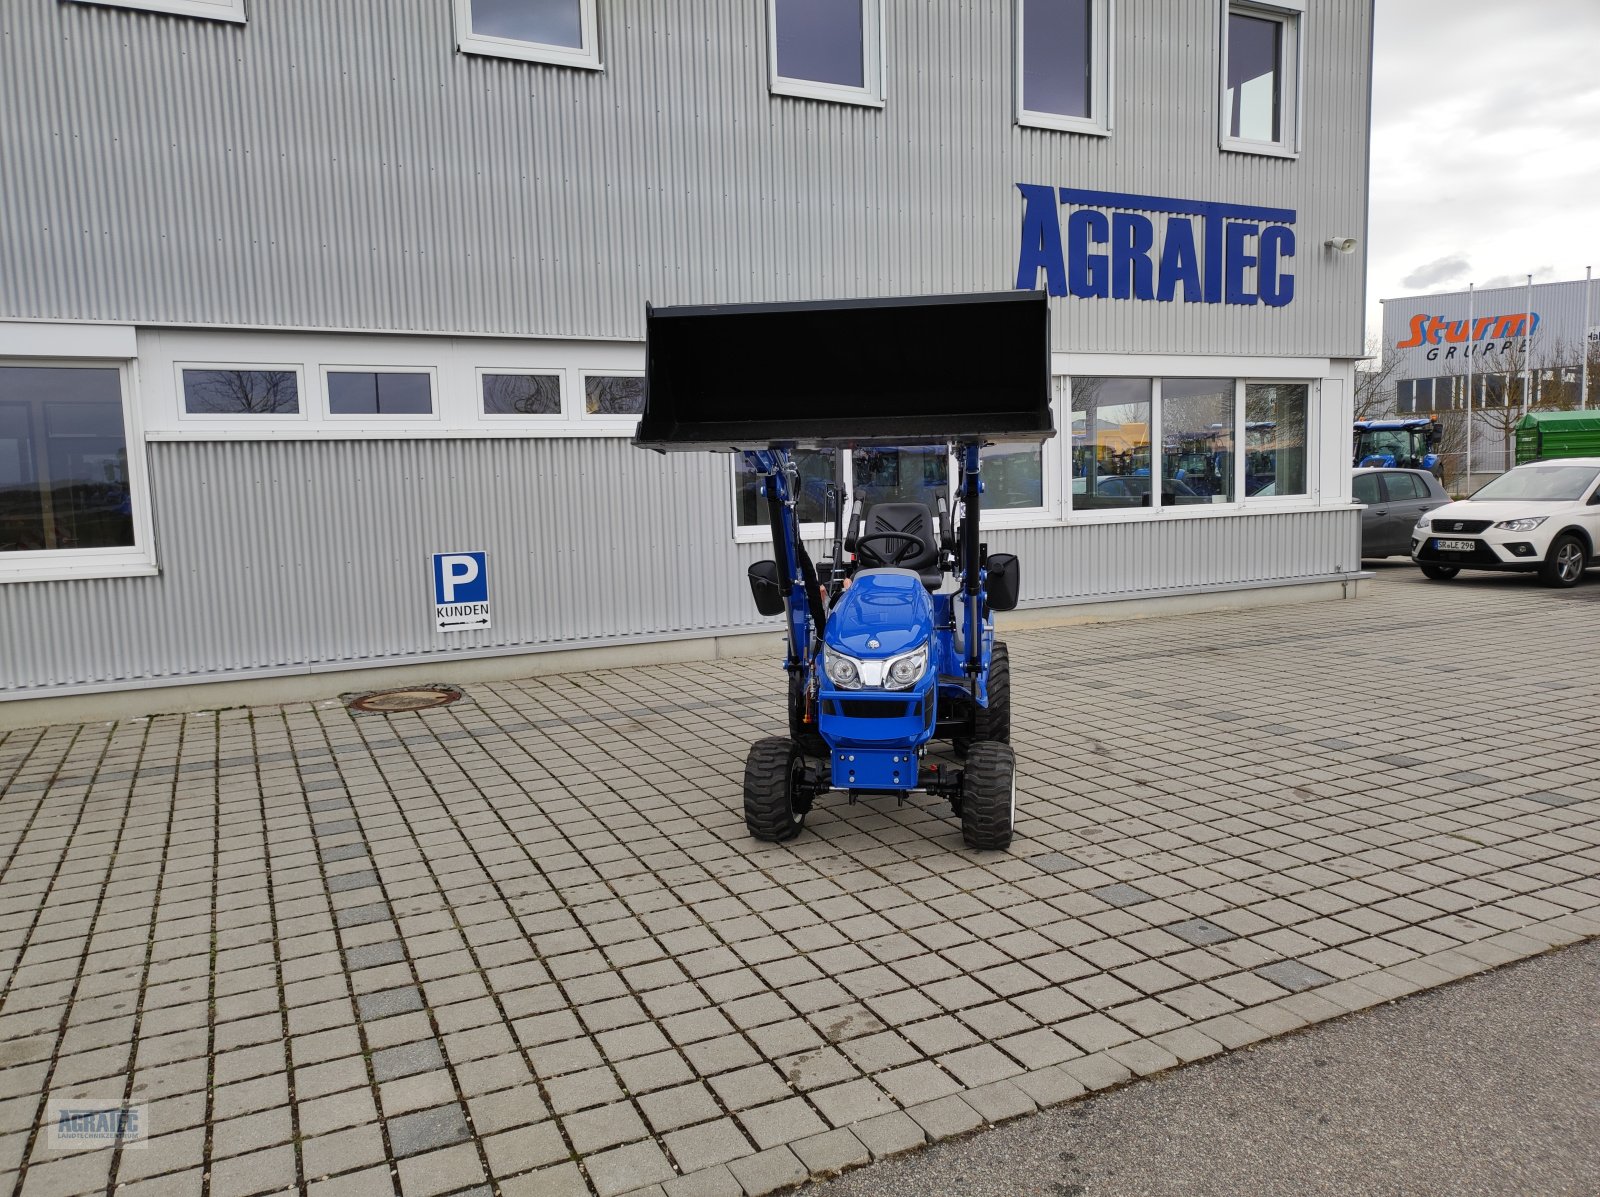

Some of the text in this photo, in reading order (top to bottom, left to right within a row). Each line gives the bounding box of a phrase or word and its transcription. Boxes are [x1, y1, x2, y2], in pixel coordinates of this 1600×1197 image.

[1015, 182, 1297, 308] AGRATEC
[1396, 311, 1541, 349] Sturm
[1426, 337, 1533, 361] GRUPPE
[1460, 541, 1474, 550] 296
[441, 555, 479, 602] P
[436, 603, 489, 618] KUNDEN
